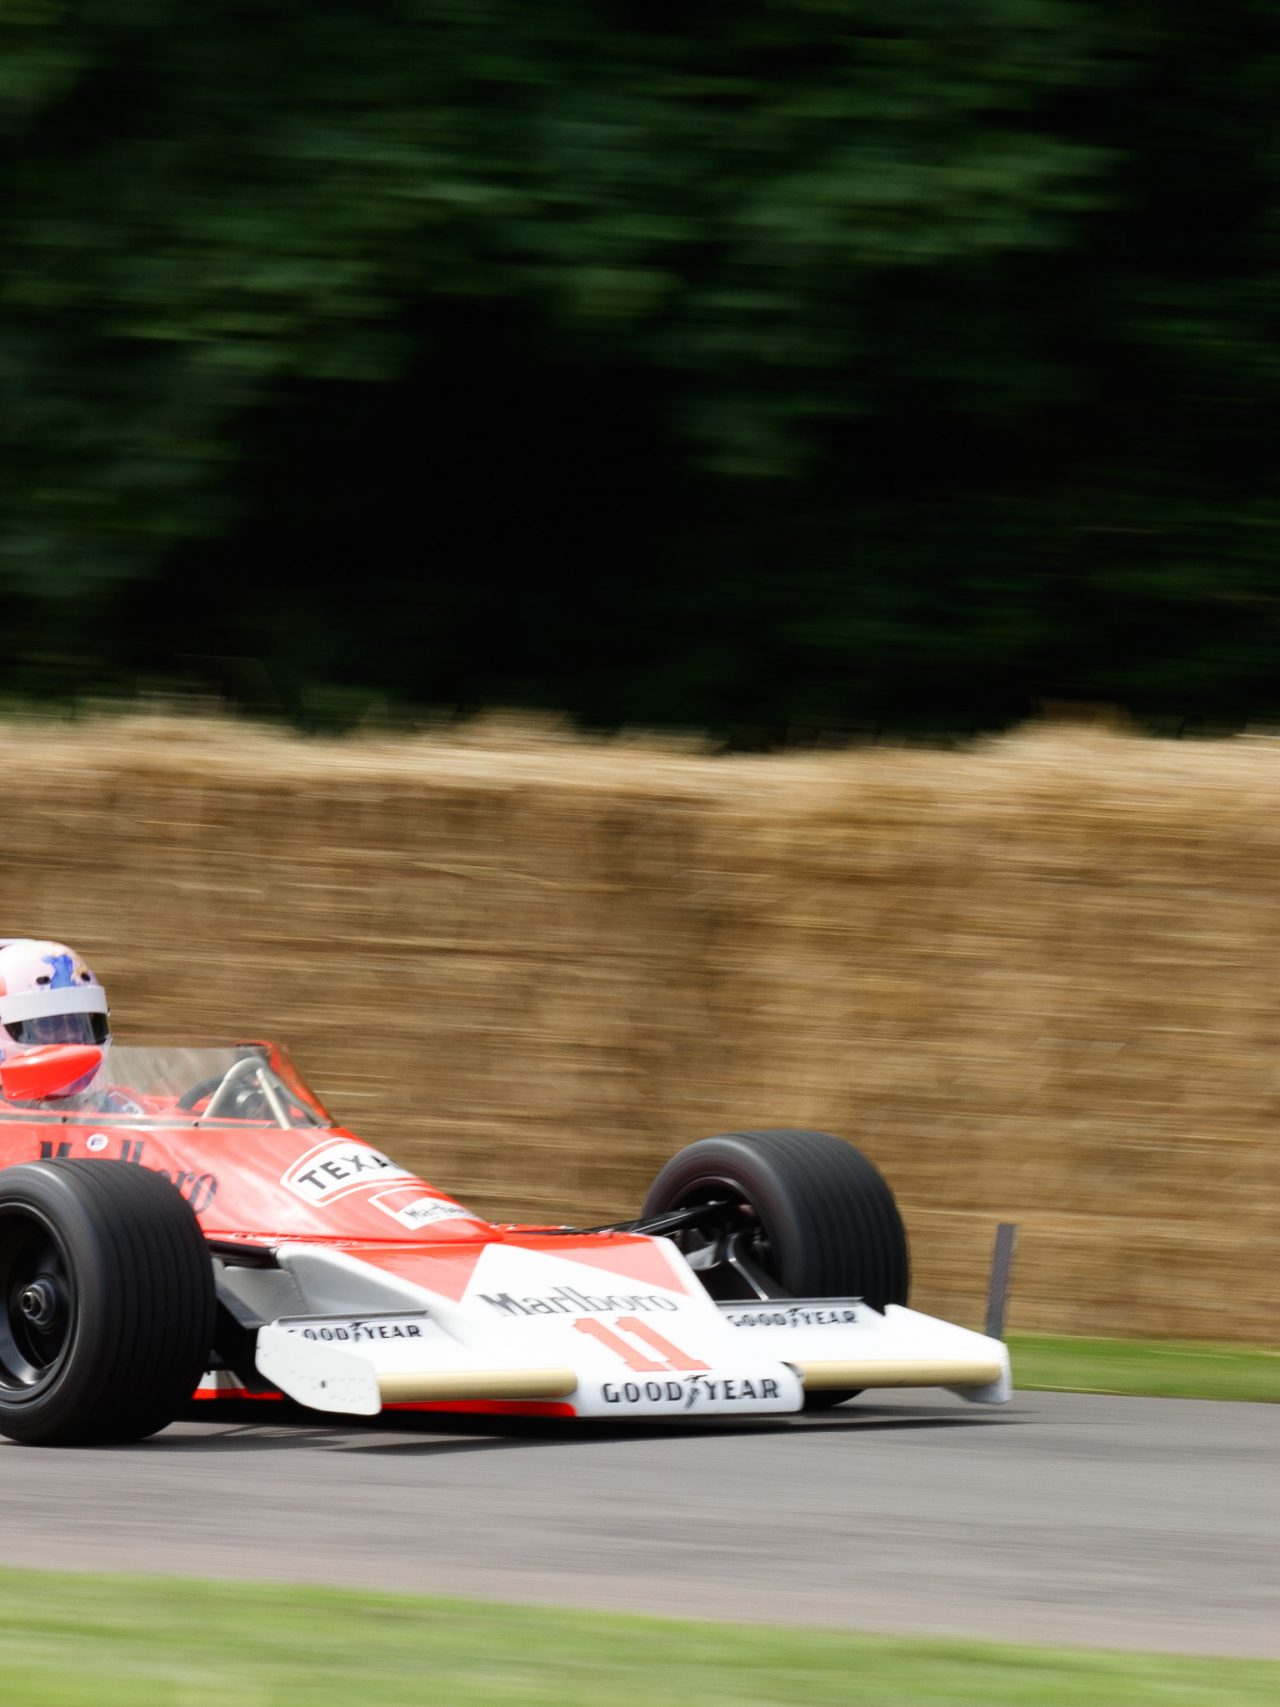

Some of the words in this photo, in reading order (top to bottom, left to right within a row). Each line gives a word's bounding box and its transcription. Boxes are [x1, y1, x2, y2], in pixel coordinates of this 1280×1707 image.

[297, 1154, 392, 1190] TEXA
[476, 1286, 680, 1316] Marlboro
[287, 1324, 424, 1342] OODYEAR
[571, 1316, 715, 1373] 11
